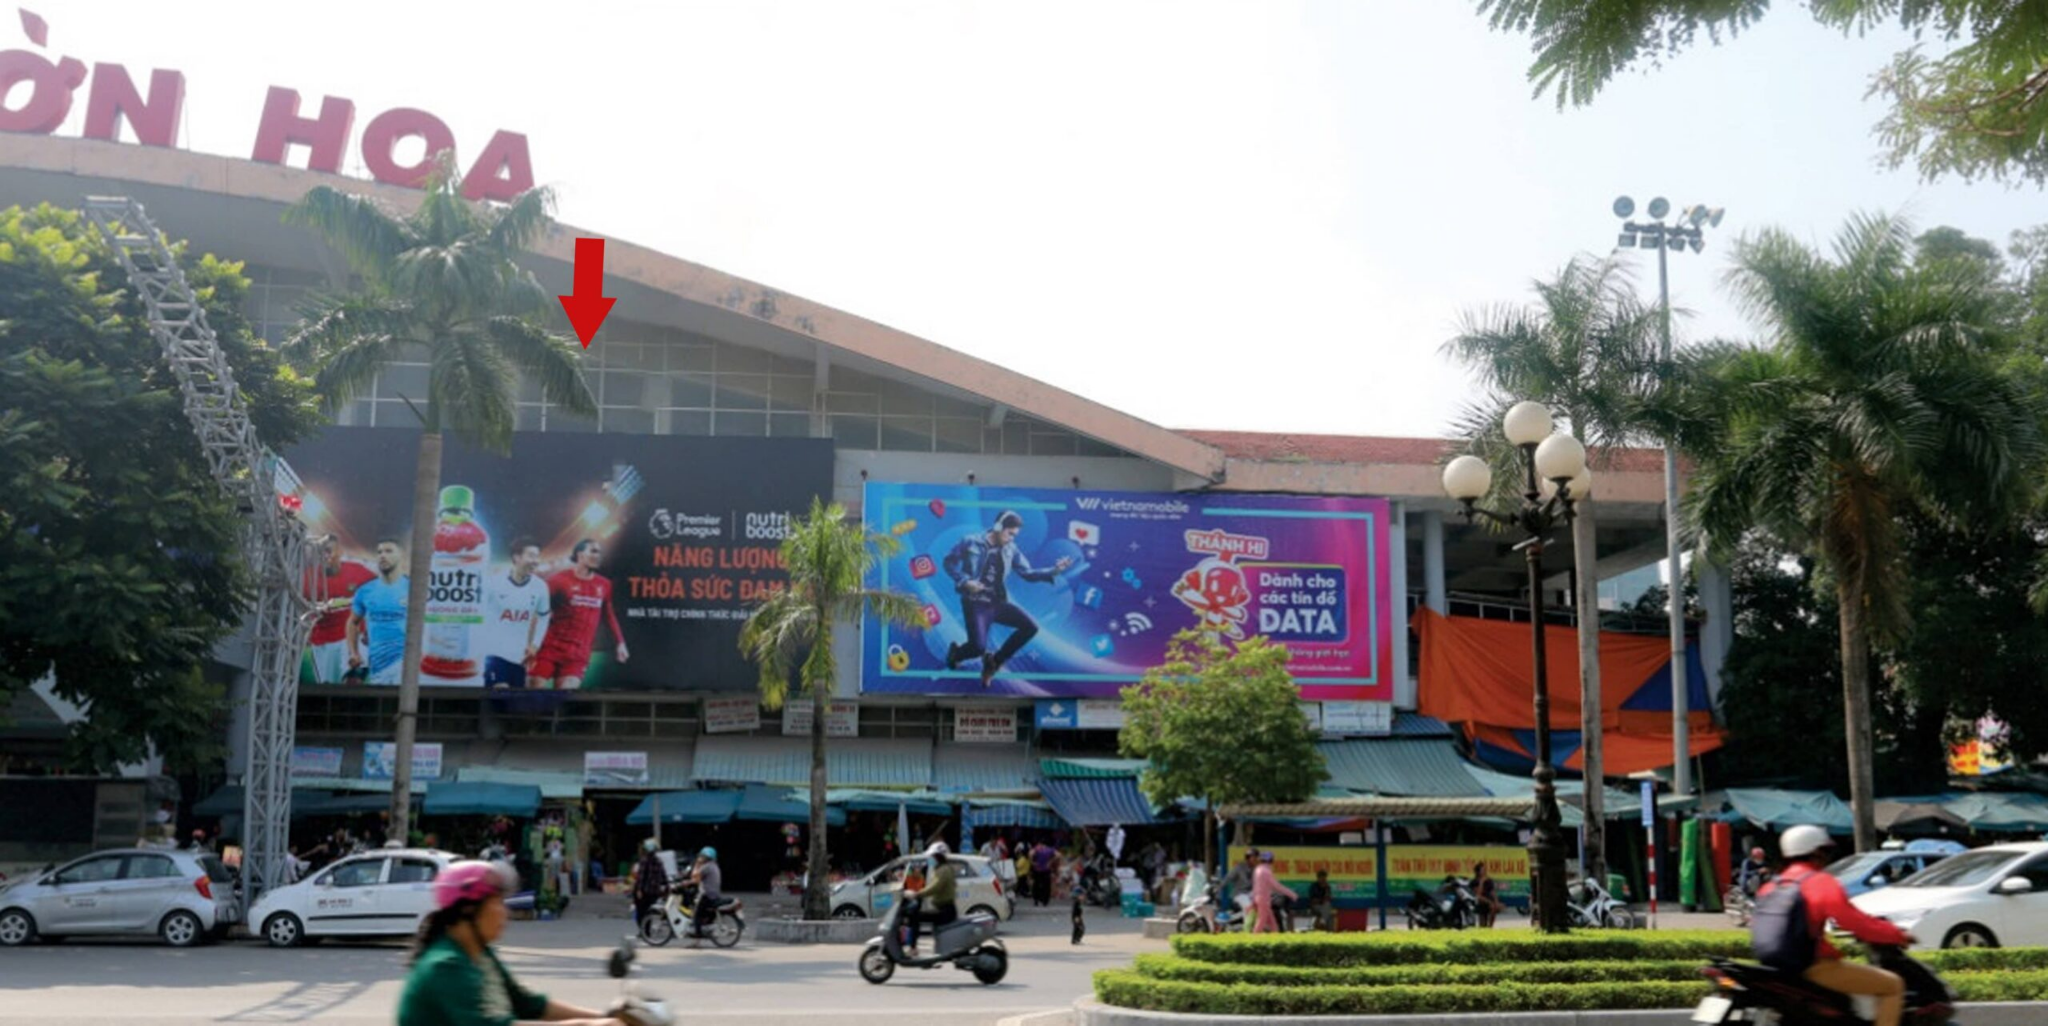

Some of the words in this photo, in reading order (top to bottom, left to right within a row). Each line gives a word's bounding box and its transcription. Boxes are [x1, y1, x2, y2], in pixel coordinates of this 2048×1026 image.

[251, 85, 535, 202] HOA
[1101, 498, 1189, 513] vietnamobile
[675, 512, 721, 525] Premier
[746, 511, 790, 526] nutri
[675, 525, 721, 539] League
[746, 524, 790, 540] boost
[1190, 531, 1244, 551] THÁNH
[653, 543, 714, 568] NĂNG
[628, 570, 685, 598] THỎA
[691, 573, 733, 599] SỨC
[1259, 572, 1304, 588] Dành
[1306, 573, 1337, 589] cho
[1259, 590, 1289, 605] các
[1291, 590, 1313, 605] tín
[1259, 608, 1338, 634] DATA
